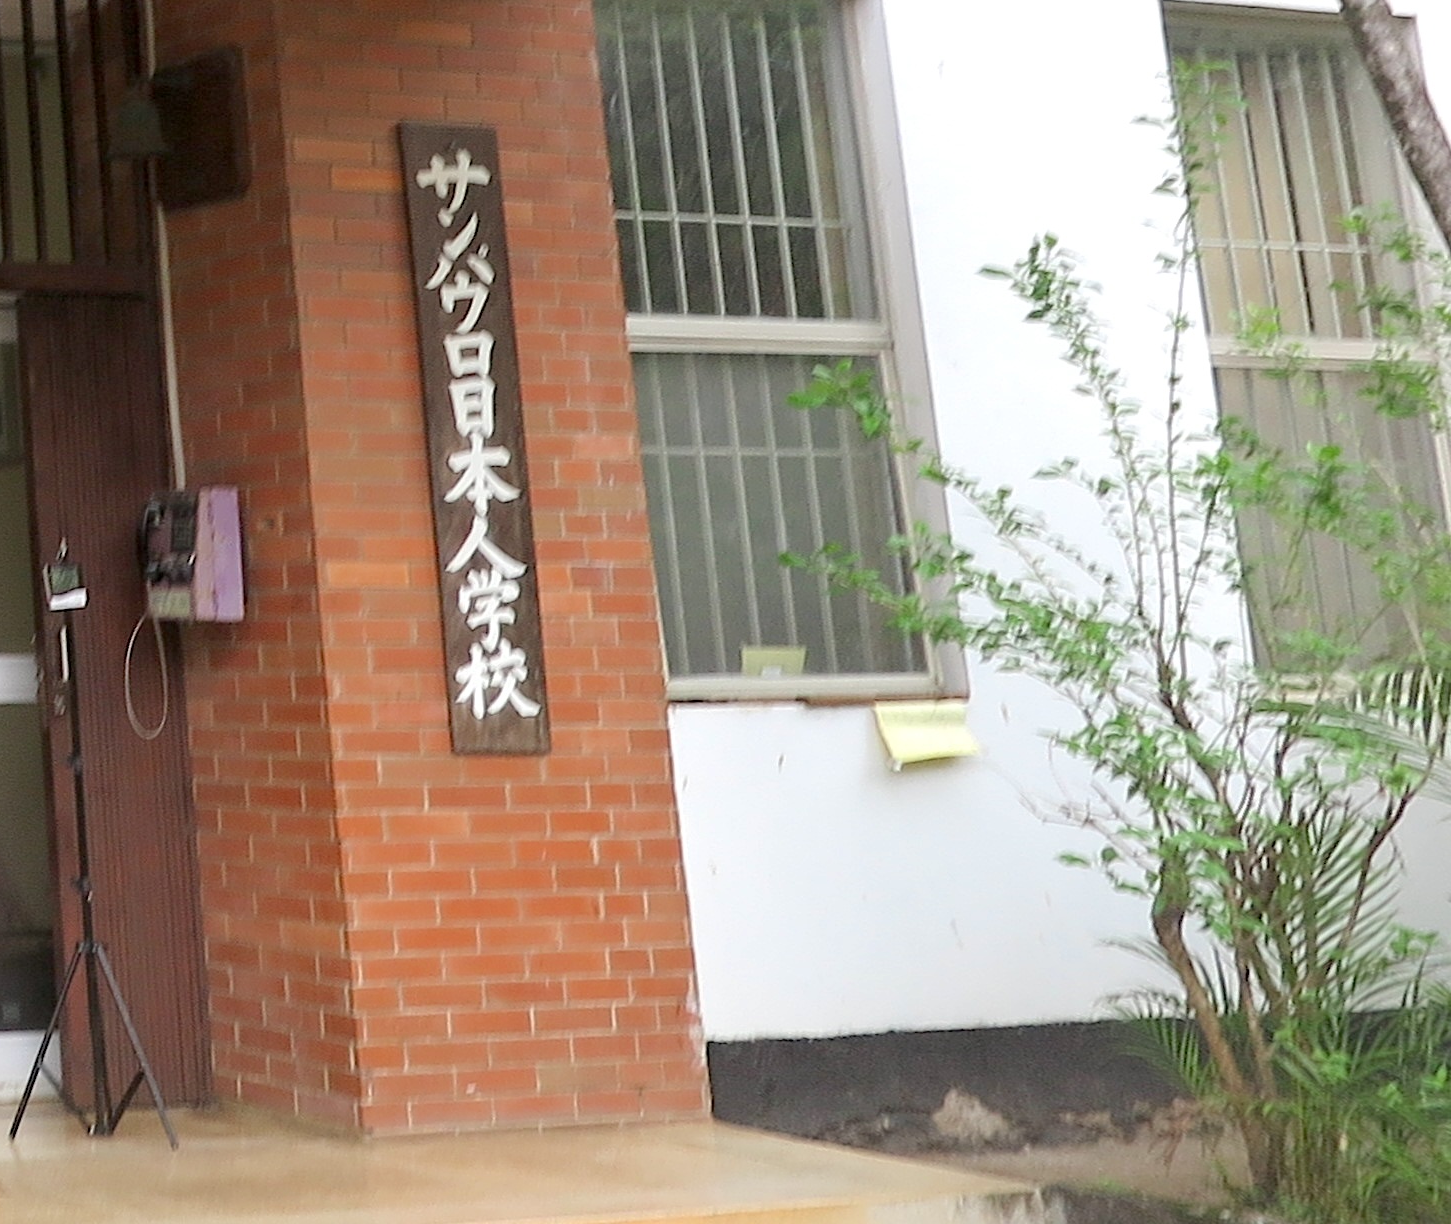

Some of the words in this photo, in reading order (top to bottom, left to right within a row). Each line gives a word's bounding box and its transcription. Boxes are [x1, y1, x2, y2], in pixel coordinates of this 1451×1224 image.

[415, 147, 543, 719] サンパウロ日本人学校
